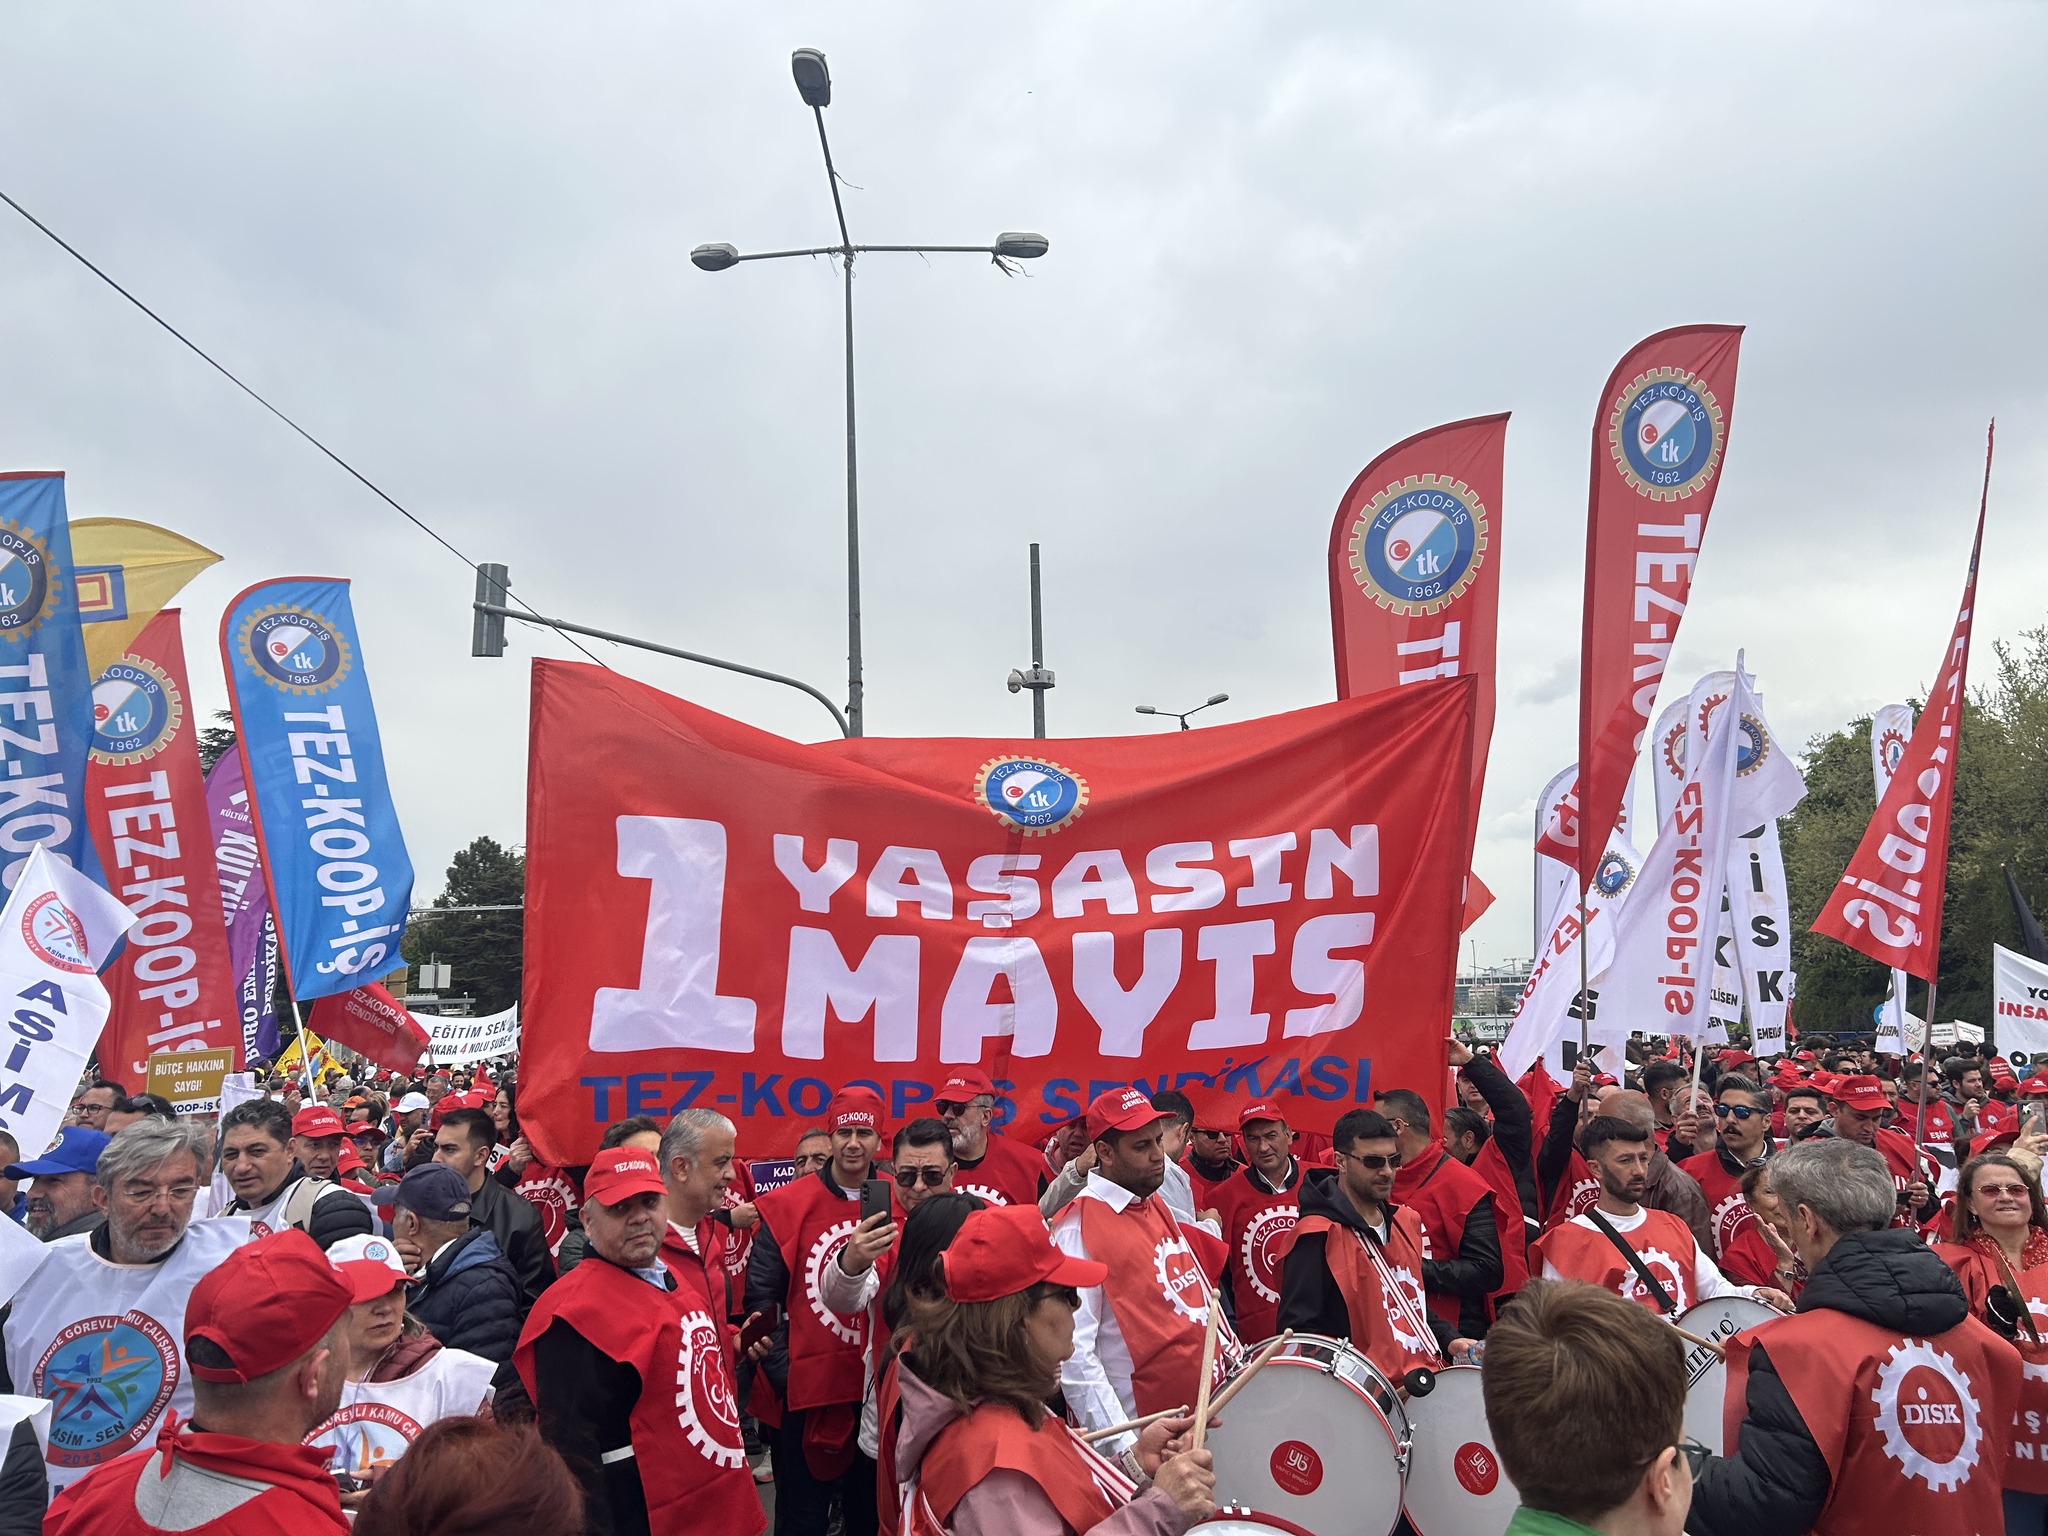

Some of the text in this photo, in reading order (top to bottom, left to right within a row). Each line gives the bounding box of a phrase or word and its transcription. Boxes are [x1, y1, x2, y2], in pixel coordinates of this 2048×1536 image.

[1661, 438, 1680, 463] tk
[1650, 470, 1681, 484] 1962
[1374, 494, 1467, 531] TEZ-KOOP-İŞ
[1416, 549, 1440, 576] tk
[1407, 582, 1443, 598] 1962
[256, 615, 331, 641] TEZ-KOOP-İŞ
[293, 652, 313, 669] tk
[288, 675, 318, 684] 1962
[115, 712, 139, 733] tk
[109, 738, 142, 751] 1962
[1029, 790, 1050, 808] tk
[1024, 812, 1053, 825] 1962
[284, 705, 400, 975] TEZ-KOOP-İŞ
[773, 824, 1379, 928] YAŞASIN
[588, 814, 757, 1053] 1
[781, 912, 1375, 1064] MAYIS
[345, 1001, 396, 1035] SENDİKASI
[1999, 997, 2048, 1021] İNSA
[431, 1019, 507, 1039] EĞİTİM SEN
[426, 1044, 457, 1056] NKARA
[460, 1043, 468, 1054] 4
[155, 1059, 224, 1076] BÜTÇE HAKKINA
[174, 1080, 202, 1093] SAYGI!
[65, 1317, 118, 1339] GÖREVLİ
[369, 1407, 403, 1426] KAMU
[50, 1428, 84, 1446] ASİM
[95, 1420, 126, 1443] SEN
[63, 1451, 102, 1465] 2013
